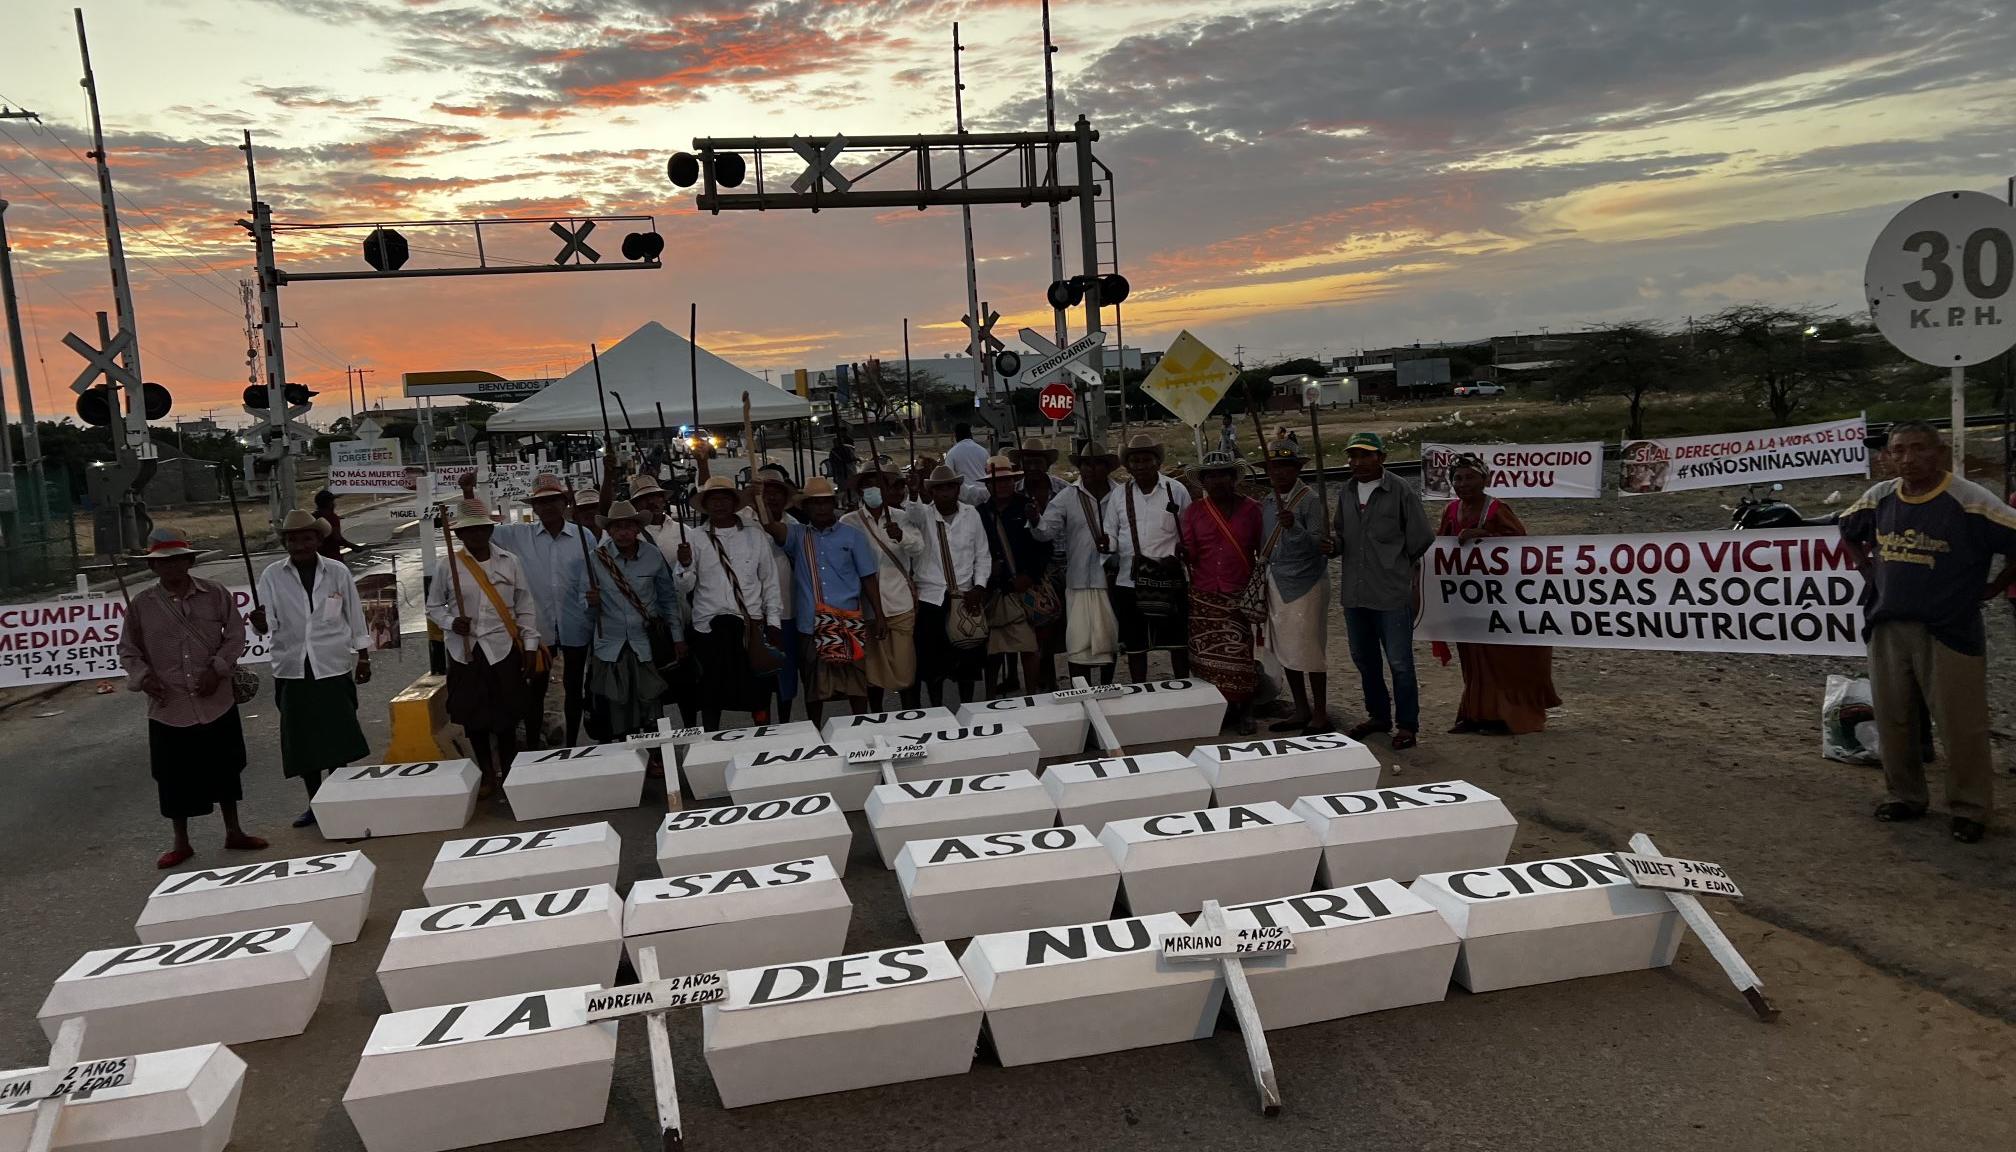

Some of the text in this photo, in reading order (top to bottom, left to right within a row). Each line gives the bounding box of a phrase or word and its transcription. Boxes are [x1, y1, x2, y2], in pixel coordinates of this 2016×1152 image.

[1902, 227, 2014, 302] 30
[1031, 337, 1096, 378] FERROCARRIL
[479, 381, 540, 392] BIENVENIDOS
[1041, 394, 1073, 409] PARE
[1655, 447, 1671, 462] AL
[1675, 441, 1742, 459] DERECHO
[1745, 441, 1755, 452] A
[1759, 438, 1775, 451] LA
[1818, 430, 1835, 444] DE
[1838, 427, 1865, 442] LOS
[1493, 450, 1592, 467] GENOCIDIO
[1677, 446, 1866, 480] #NIÑOSNIÑASWAYUU
[330, 479, 348, 487] POR
[332, 470, 346, 478] NO
[368, 470, 406, 478] MUERTES
[390, 510, 417, 518] MIGUEL
[1520, 545, 1564, 575] DE
[1574, 542, 1691, 576] 5.000
[1440, 578, 1508, 605] POR
[1515, 577, 1657, 606] CAUSAS
[1488, 602, 1857, 643] A LA DESNUTRICIÓN
[46, 649, 60, 662] Y
[21, 663, 80, 679] T-415,
[350, 762, 439, 780] NO
[533, 746, 604, 764] AL
[711, 724, 782, 742] GE
[851, 709, 926, 727] NO
[986, 696, 1035, 711] CI
[750, 723, 1003, 767] WA YUU
[848, 749, 876, 759] DAVID
[158, 854, 347, 895] MAS
[459, 828, 570, 859] DE
[898, 773, 1010, 799] VIC
[1074, 757, 1140, 778] TI
[1218, 734, 1348, 761] MAS
[1625, 857, 1726, 878] YULIET 3 AÑOS
[84, 784, 1469, 977] POR CAU SAS ASO CIA DAS
[1683, 877, 1735, 893] DE EDAD
[1164, 935, 1222, 952] MARIANO
[1238, 926, 1284, 940] 4 AÑOS
[1236, 938, 1292, 953] DE EDAD
[416, 994, 552, 1047] LA
[749, 949, 929, 1005] DES
[1025, 920, 1153, 965] NU
[1227, 886, 1392, 928] TRI
[670, 972, 721, 991] 2 AÑOS
[588, 991, 654, 1012] ANDREINA
[671, 988, 724, 1006] DE EDAD
[63, 1058, 127, 1081] 2 AÑOS
[50, 1073, 125, 1097] DE EDAD
